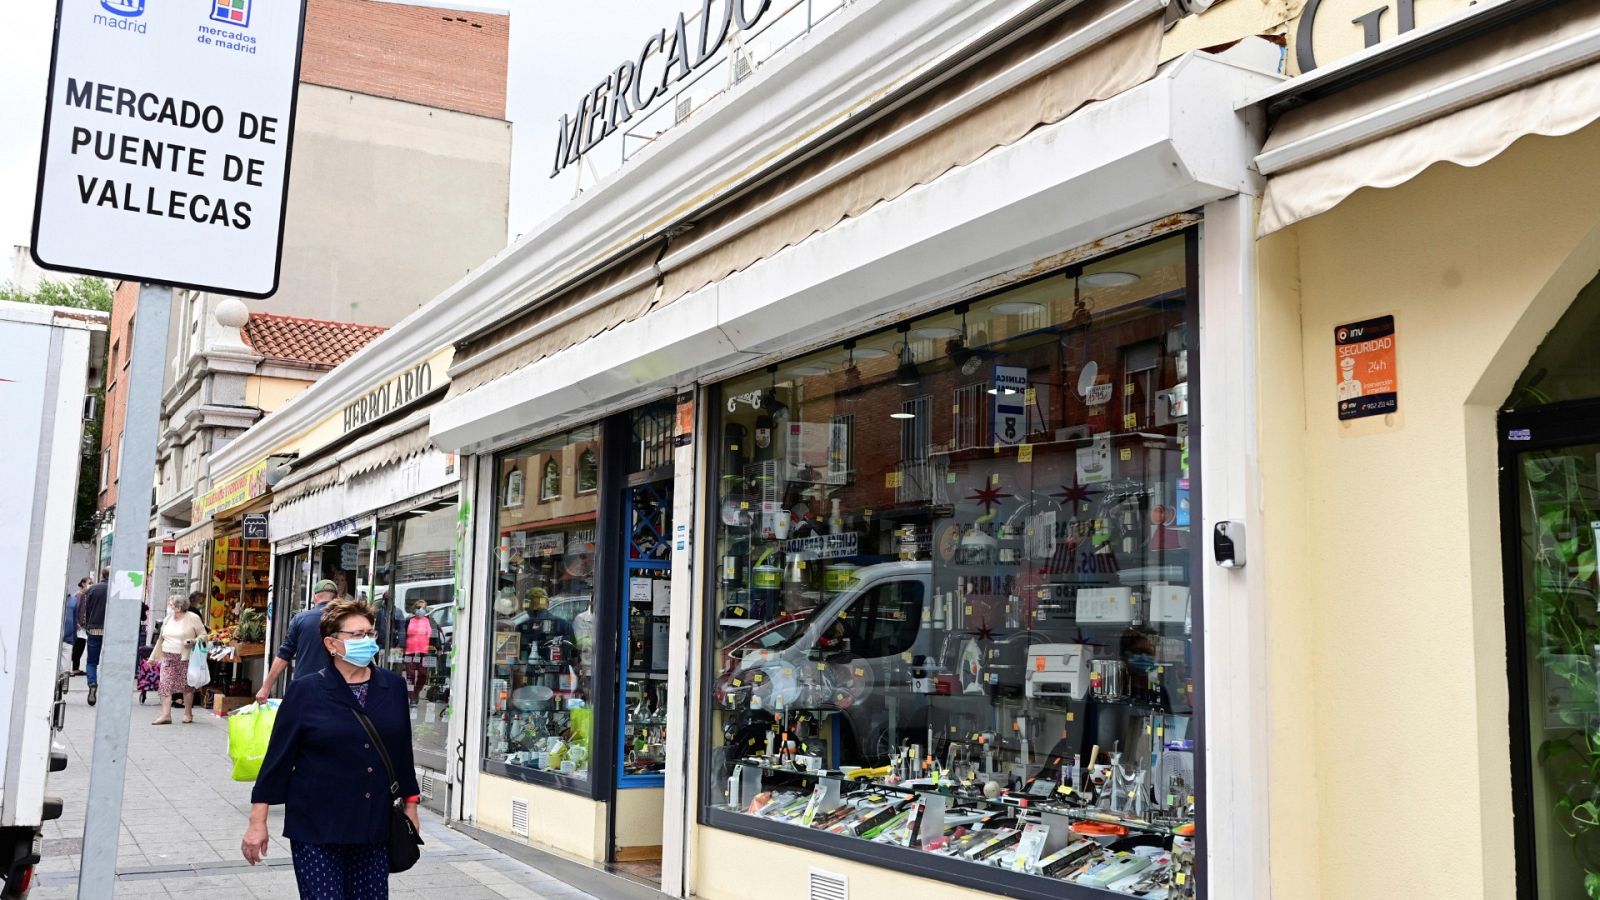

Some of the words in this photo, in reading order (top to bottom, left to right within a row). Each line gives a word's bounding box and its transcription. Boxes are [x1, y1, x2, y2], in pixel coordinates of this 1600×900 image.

[93, 13, 147, 34] madrid
[197, 35, 212, 46] de
[215, 37, 257, 55] madrid
[198, 25, 257, 44] mercados
[65, 77, 224, 134] MERCADO
[238, 112, 279, 145] DE
[71, 126, 207, 177] PUENTE
[223, 154, 265, 187] DE
[77, 174, 253, 230] VALLECAS
[1339, 337, 1392, 357] SEGURIDAD
[1367, 361, 1387, 373] 24h
[343, 362, 433, 434] HERBOLARIO
